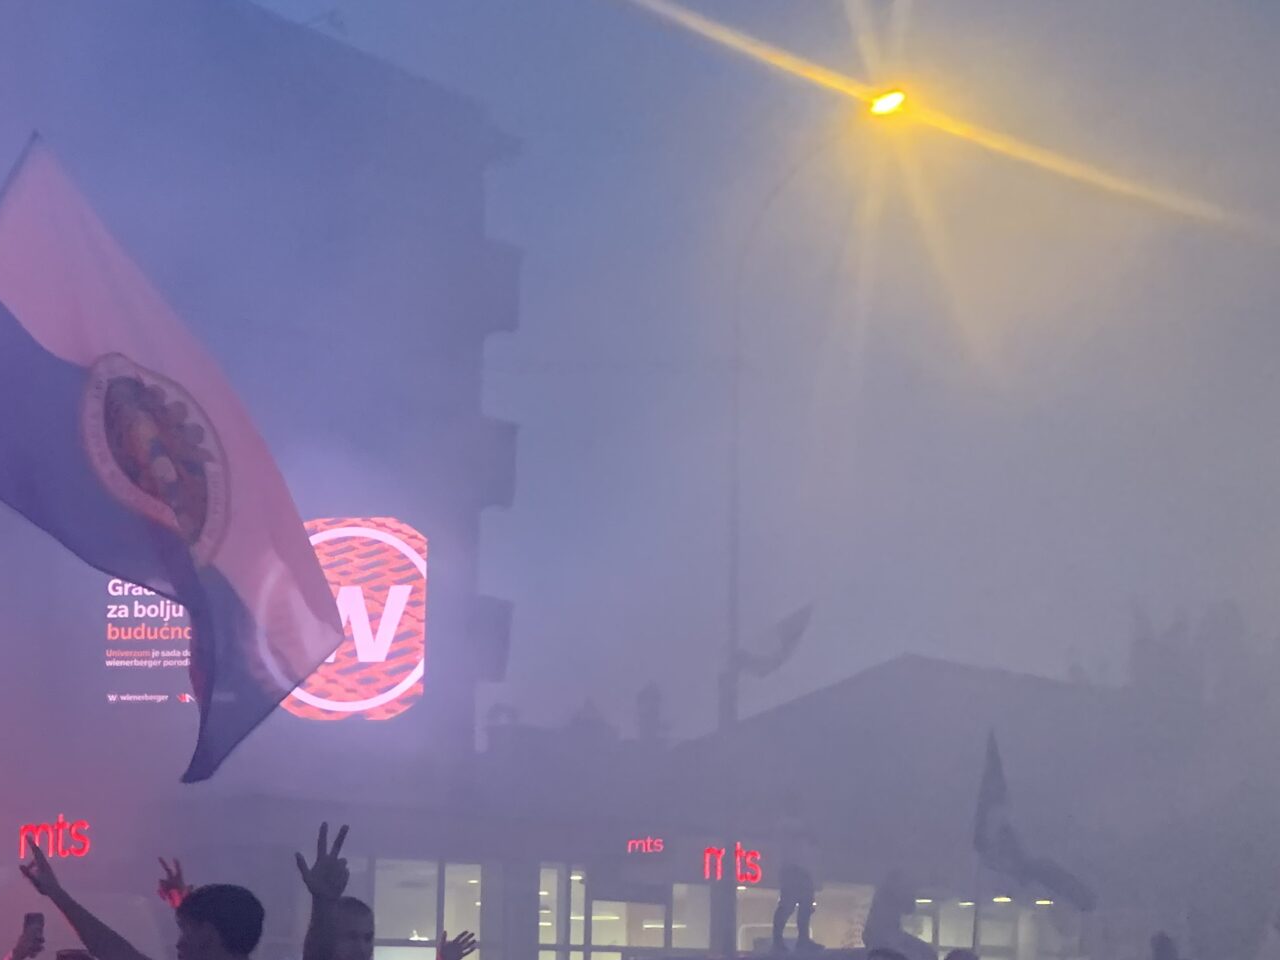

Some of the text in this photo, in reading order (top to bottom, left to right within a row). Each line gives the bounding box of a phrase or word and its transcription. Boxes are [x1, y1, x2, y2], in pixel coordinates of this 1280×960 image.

[106, 600, 184, 621] za bolju
[106, 649, 150, 657] Univerzum
[152, 649, 160, 658] je
[161, 649, 181, 657] sada
[106, 658, 161, 668] wienerberger
[20, 813, 91, 859] mts
[627, 836, 664, 853] mts
